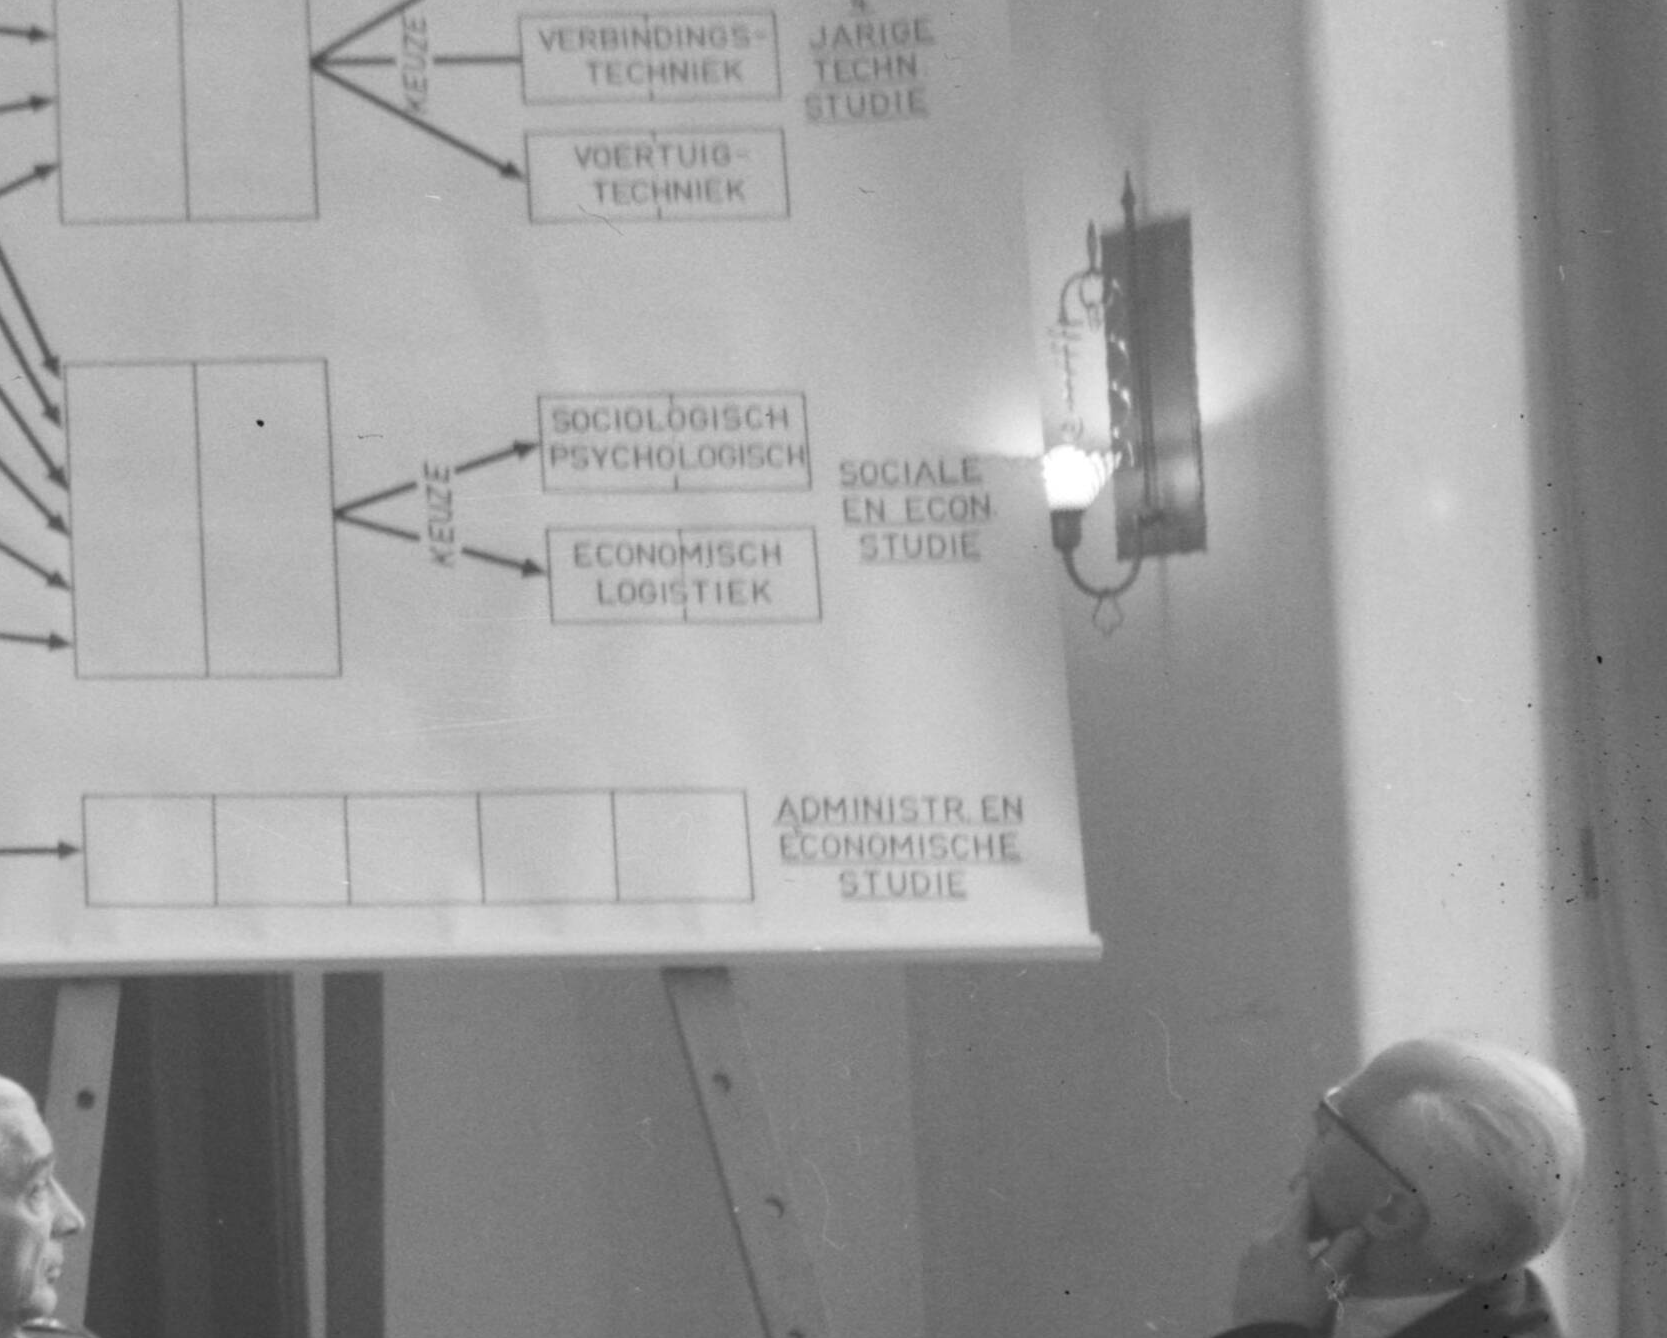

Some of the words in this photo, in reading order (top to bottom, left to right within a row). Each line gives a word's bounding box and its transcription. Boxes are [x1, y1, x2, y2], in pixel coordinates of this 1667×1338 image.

[808, 17, 936, 50] JARIGE
[586, 59, 745, 88] TECHNIEK
[804, 85, 931, 122] STUDIE
[593, 178, 748, 207] TECHNIEK
[551, 405, 789, 433] SOCIOLOGISCH
[549, 443, 807, 472] PSYCHOLOGISCH
[839, 455, 983, 488] SOCIALE
[842, 495, 886, 524] EN
[572, 540, 783, 569] ECONOMISCH
[859, 530, 982, 563] STUDIE
[596, 578, 773, 607] LOGISTIEK
[981, 794, 1024, 824] EN
[779, 831, 1023, 863] ECONOMISCHE
[838, 869, 967, 899] STUDIE
